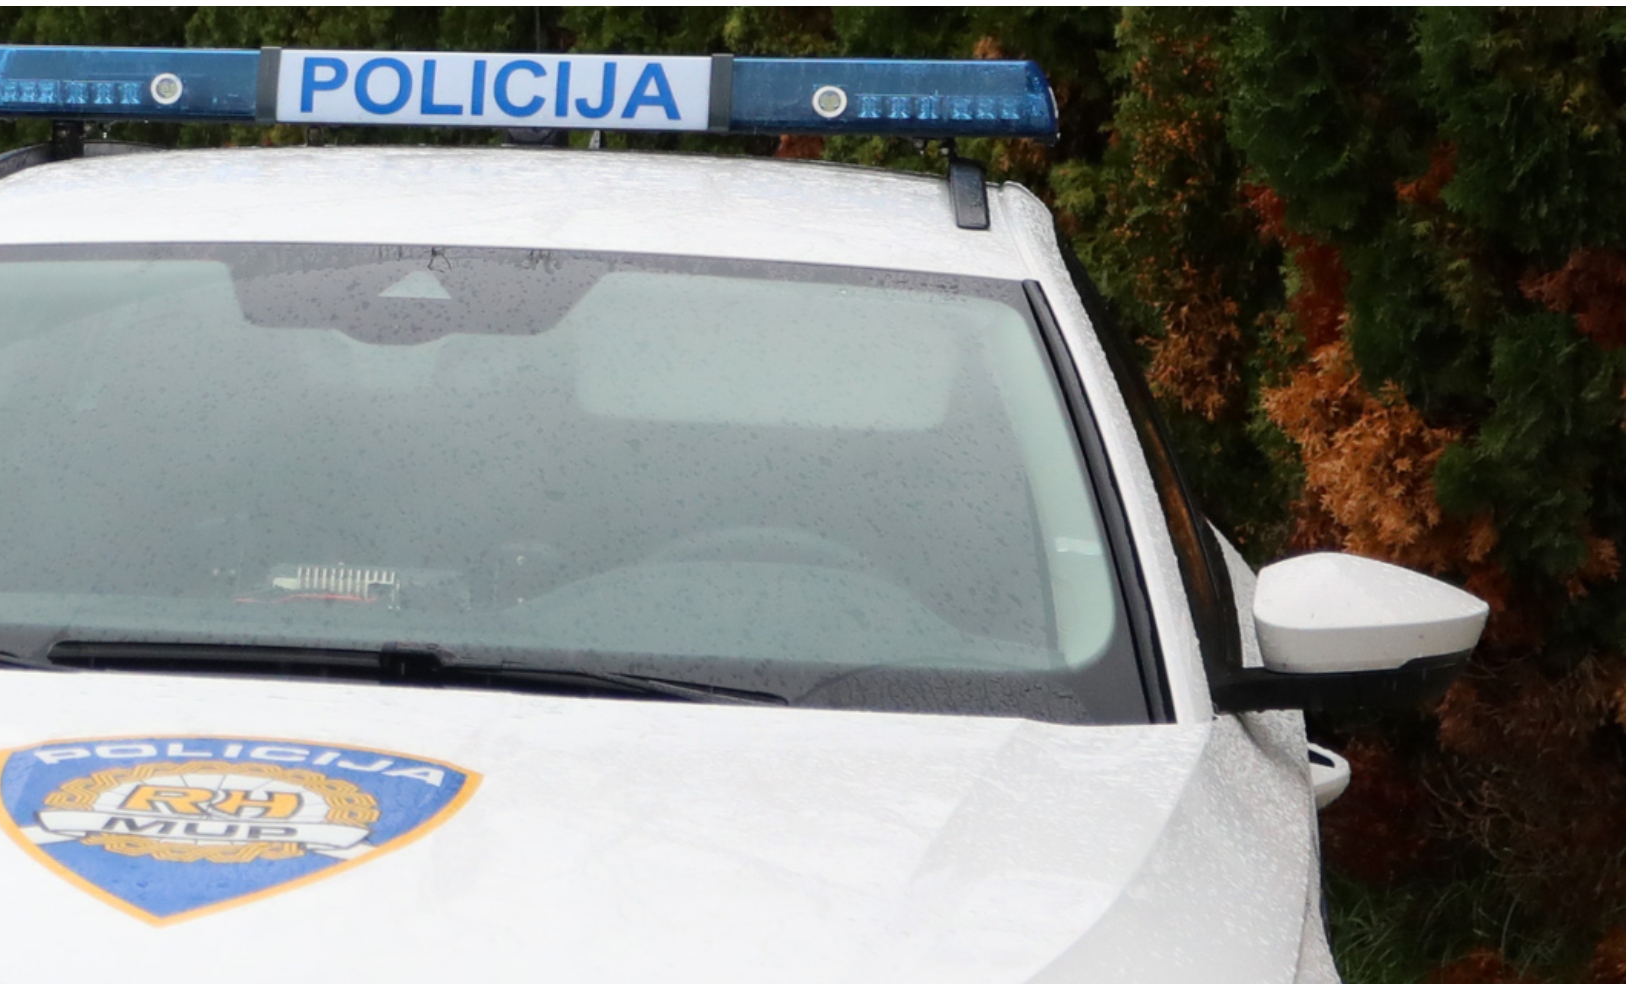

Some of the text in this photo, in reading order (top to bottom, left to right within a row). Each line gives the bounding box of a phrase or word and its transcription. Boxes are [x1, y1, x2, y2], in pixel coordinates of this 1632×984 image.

[299, 55, 682, 121] POLICIJA
[33, 742, 447, 787] POLICIJA
[119, 784, 304, 820] RH
[103, 816, 299, 840] MUP
